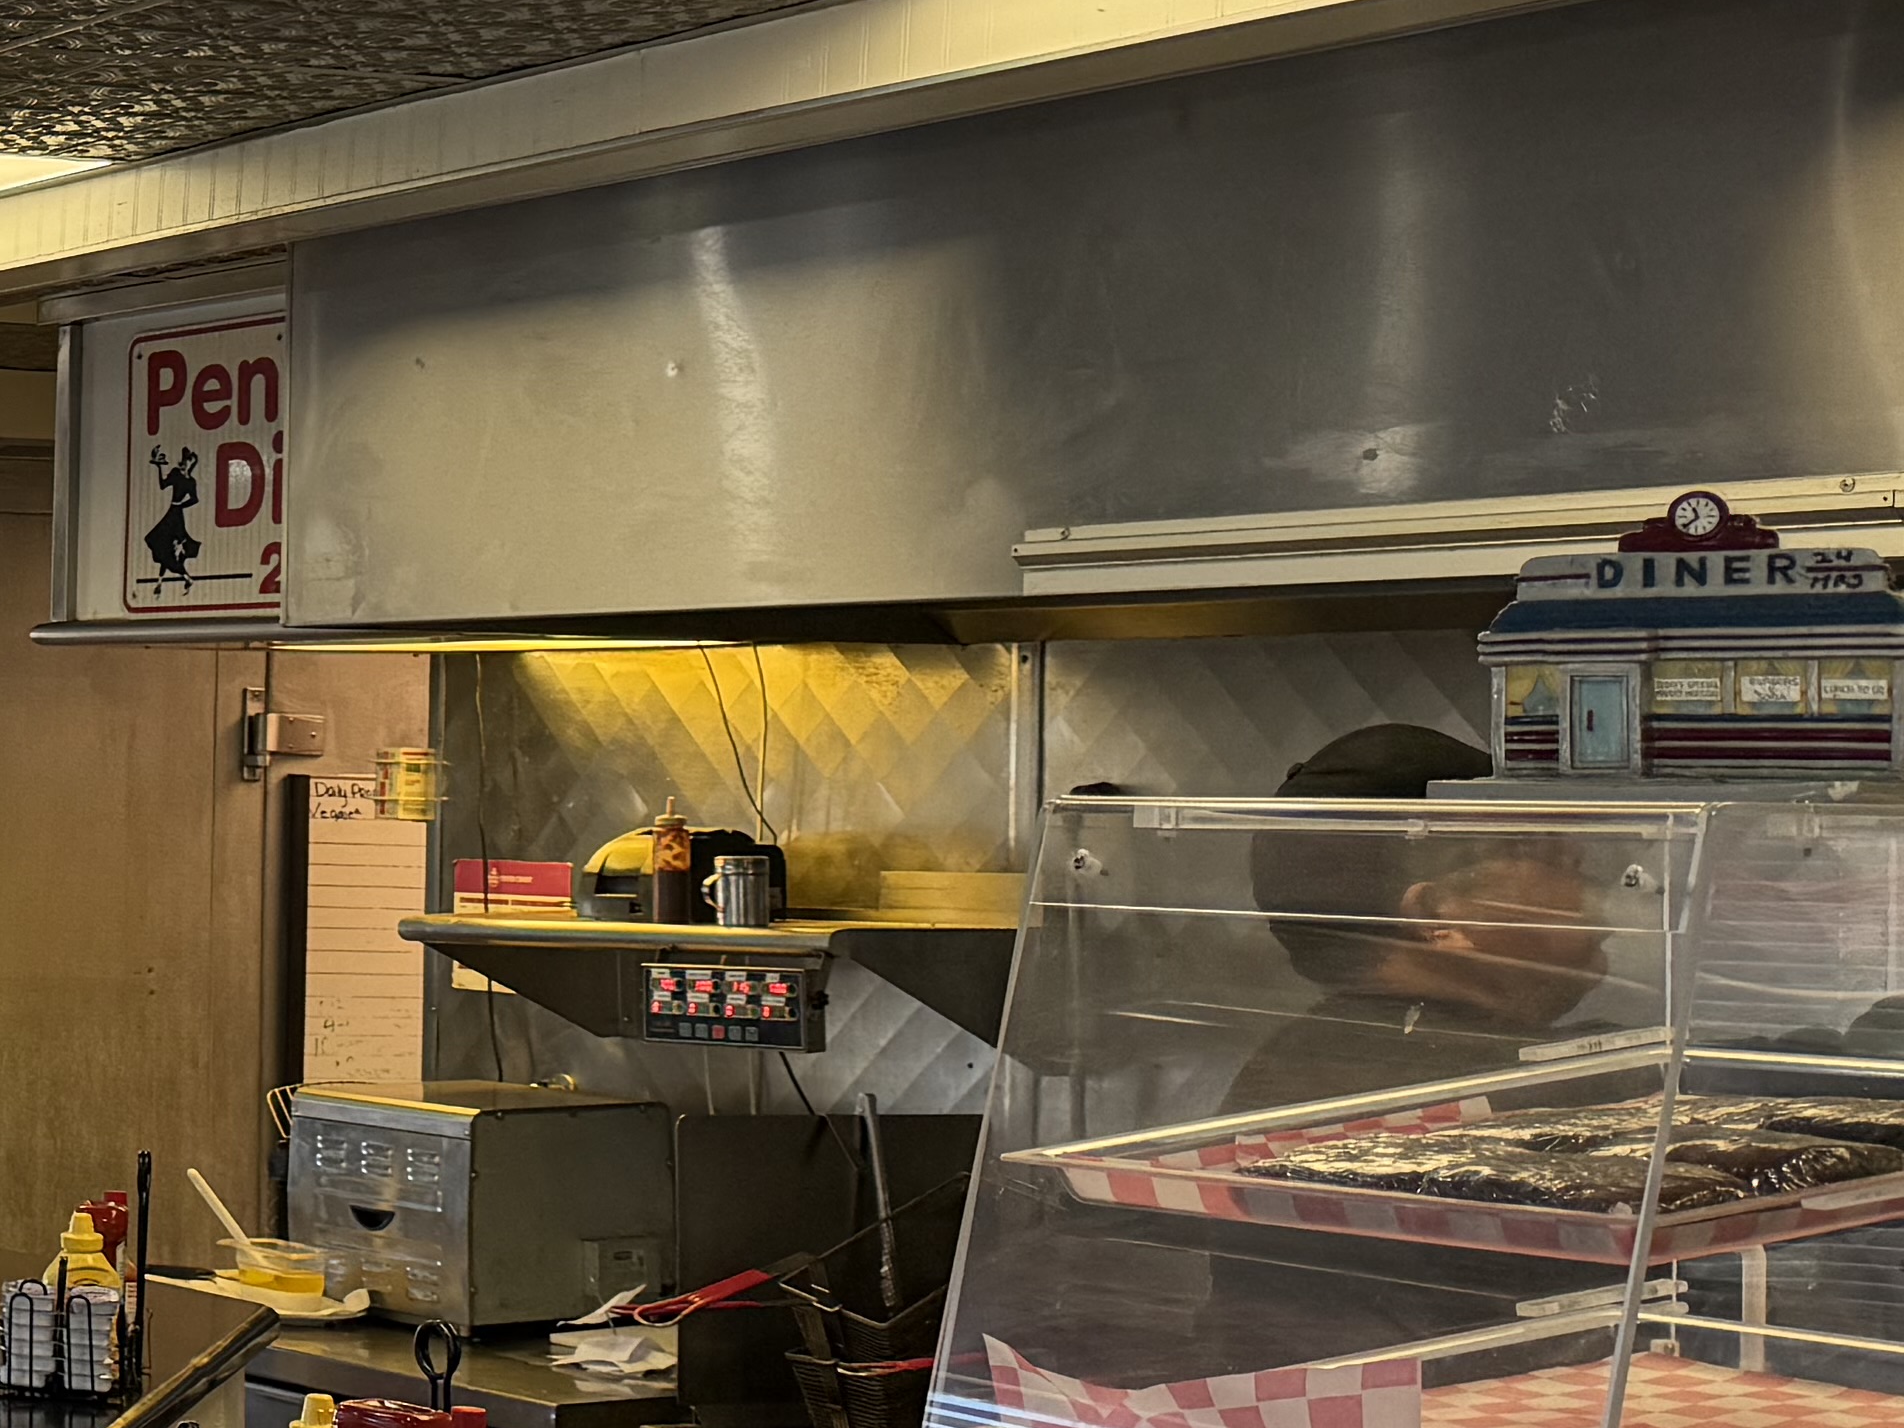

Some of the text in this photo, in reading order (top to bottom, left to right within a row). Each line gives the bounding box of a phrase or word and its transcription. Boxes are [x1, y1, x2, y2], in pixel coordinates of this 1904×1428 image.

[147, 349, 280, 436] Pen
[1596, 551, 1854, 589] DINER 24
[314, 781, 348, 808] Daily
